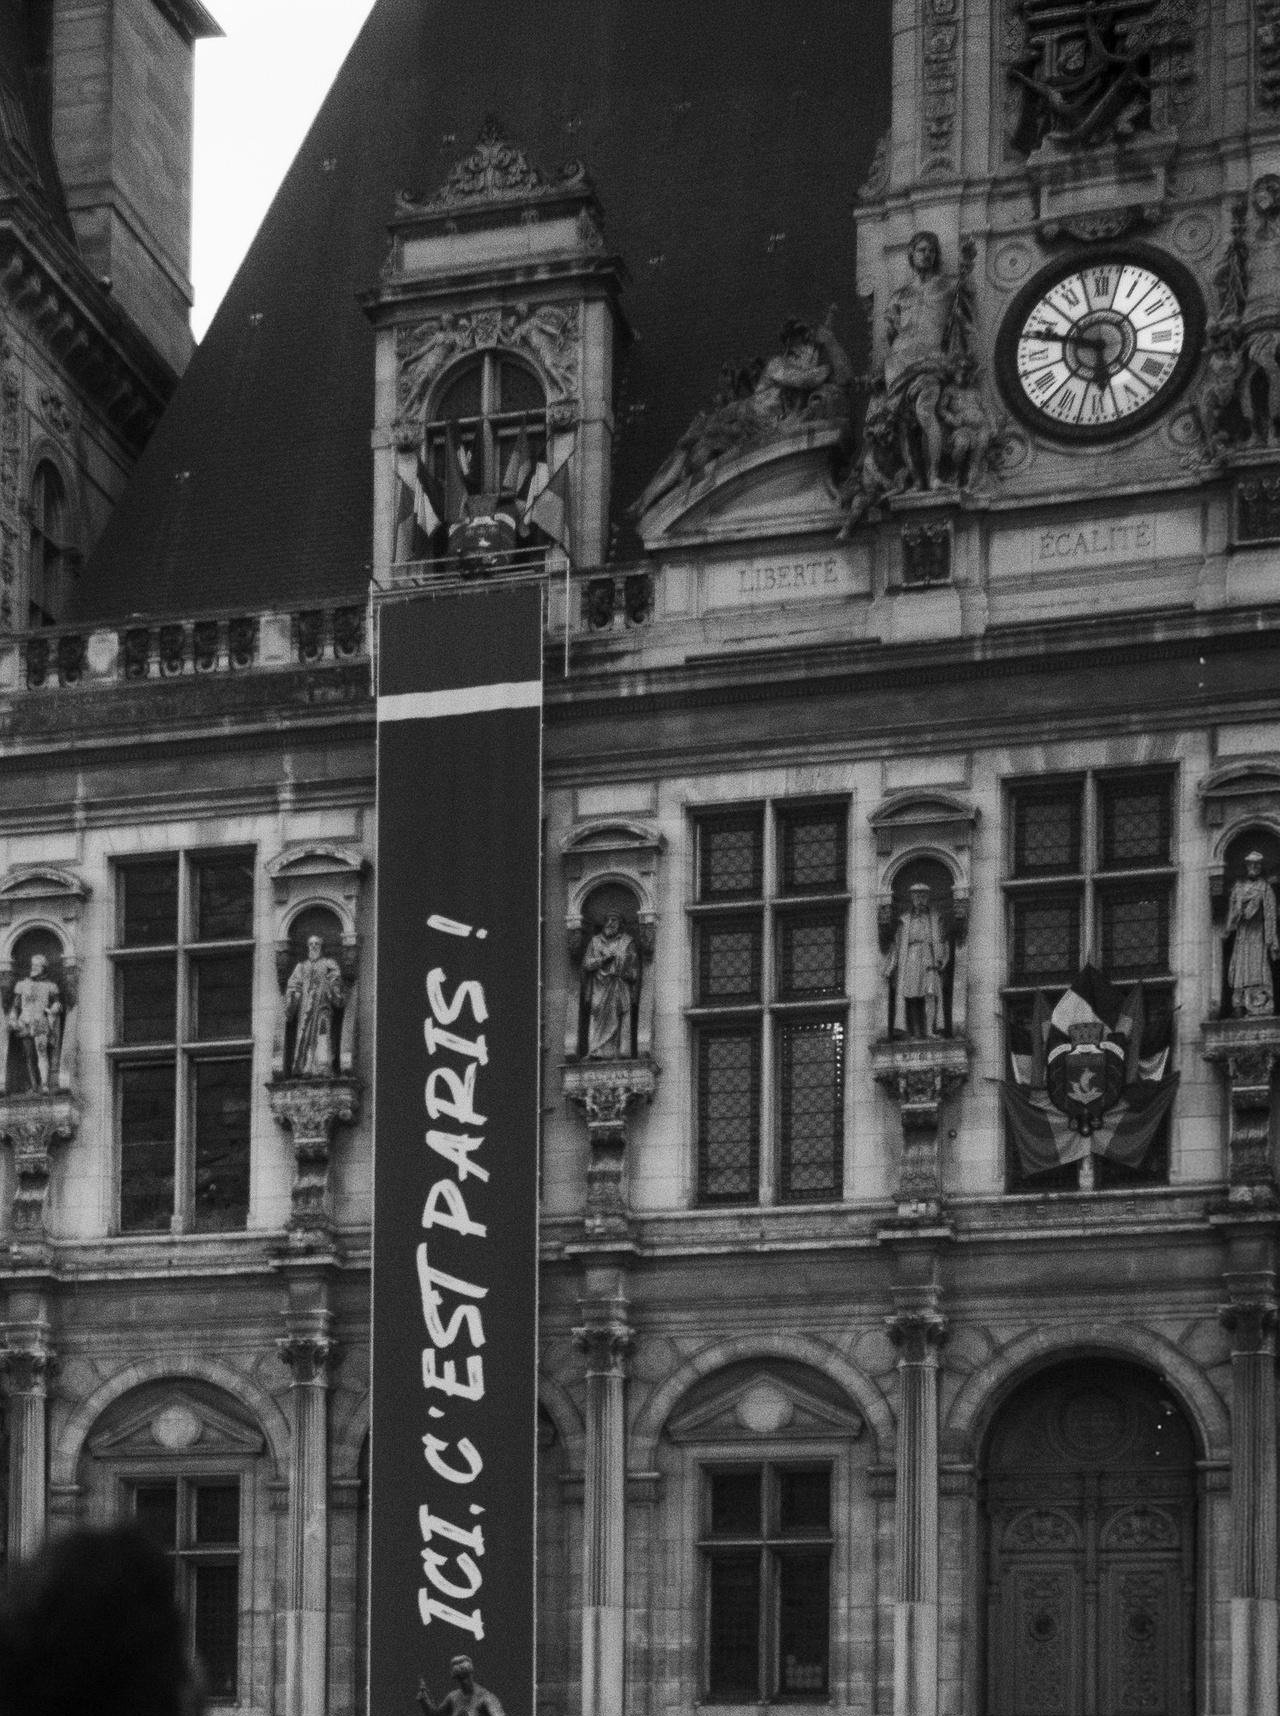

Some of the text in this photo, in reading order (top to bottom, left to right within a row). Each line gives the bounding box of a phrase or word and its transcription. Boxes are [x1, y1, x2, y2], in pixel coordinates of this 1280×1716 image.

[738, 556, 839, 593] LIBERTÉ
[423, 967, 490, 1238] PARIS
[416, 1242, 489, 1484] C'EST
